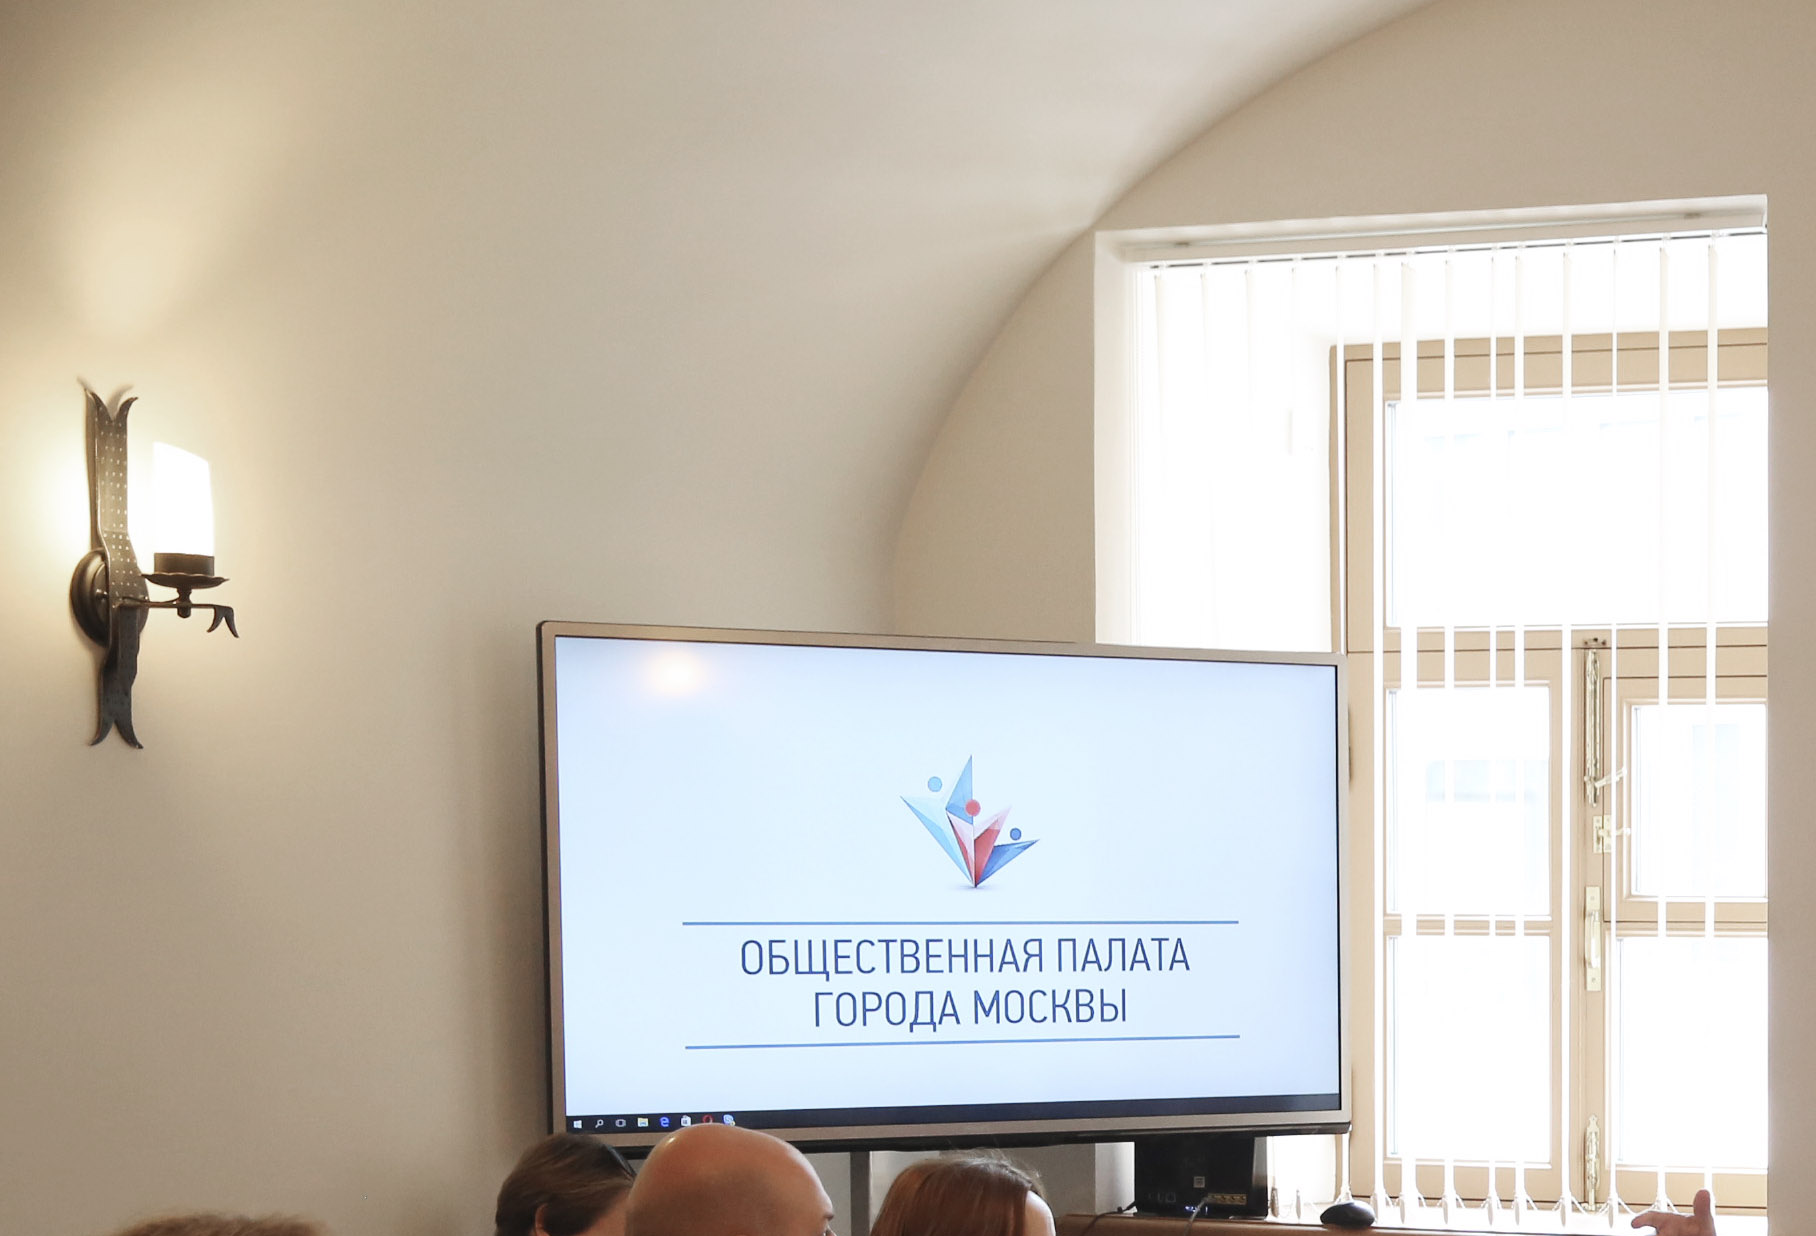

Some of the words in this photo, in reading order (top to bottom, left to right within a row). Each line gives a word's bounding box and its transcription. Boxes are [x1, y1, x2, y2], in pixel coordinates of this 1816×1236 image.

[740, 938, 1044, 983] ОБЩЕСТВЕННАЯ
[1056, 937, 1191, 973] ПАЛАТА
[813, 990, 961, 1033] ГОРОДА
[973, 988, 1128, 1025] МОСКВЫ
